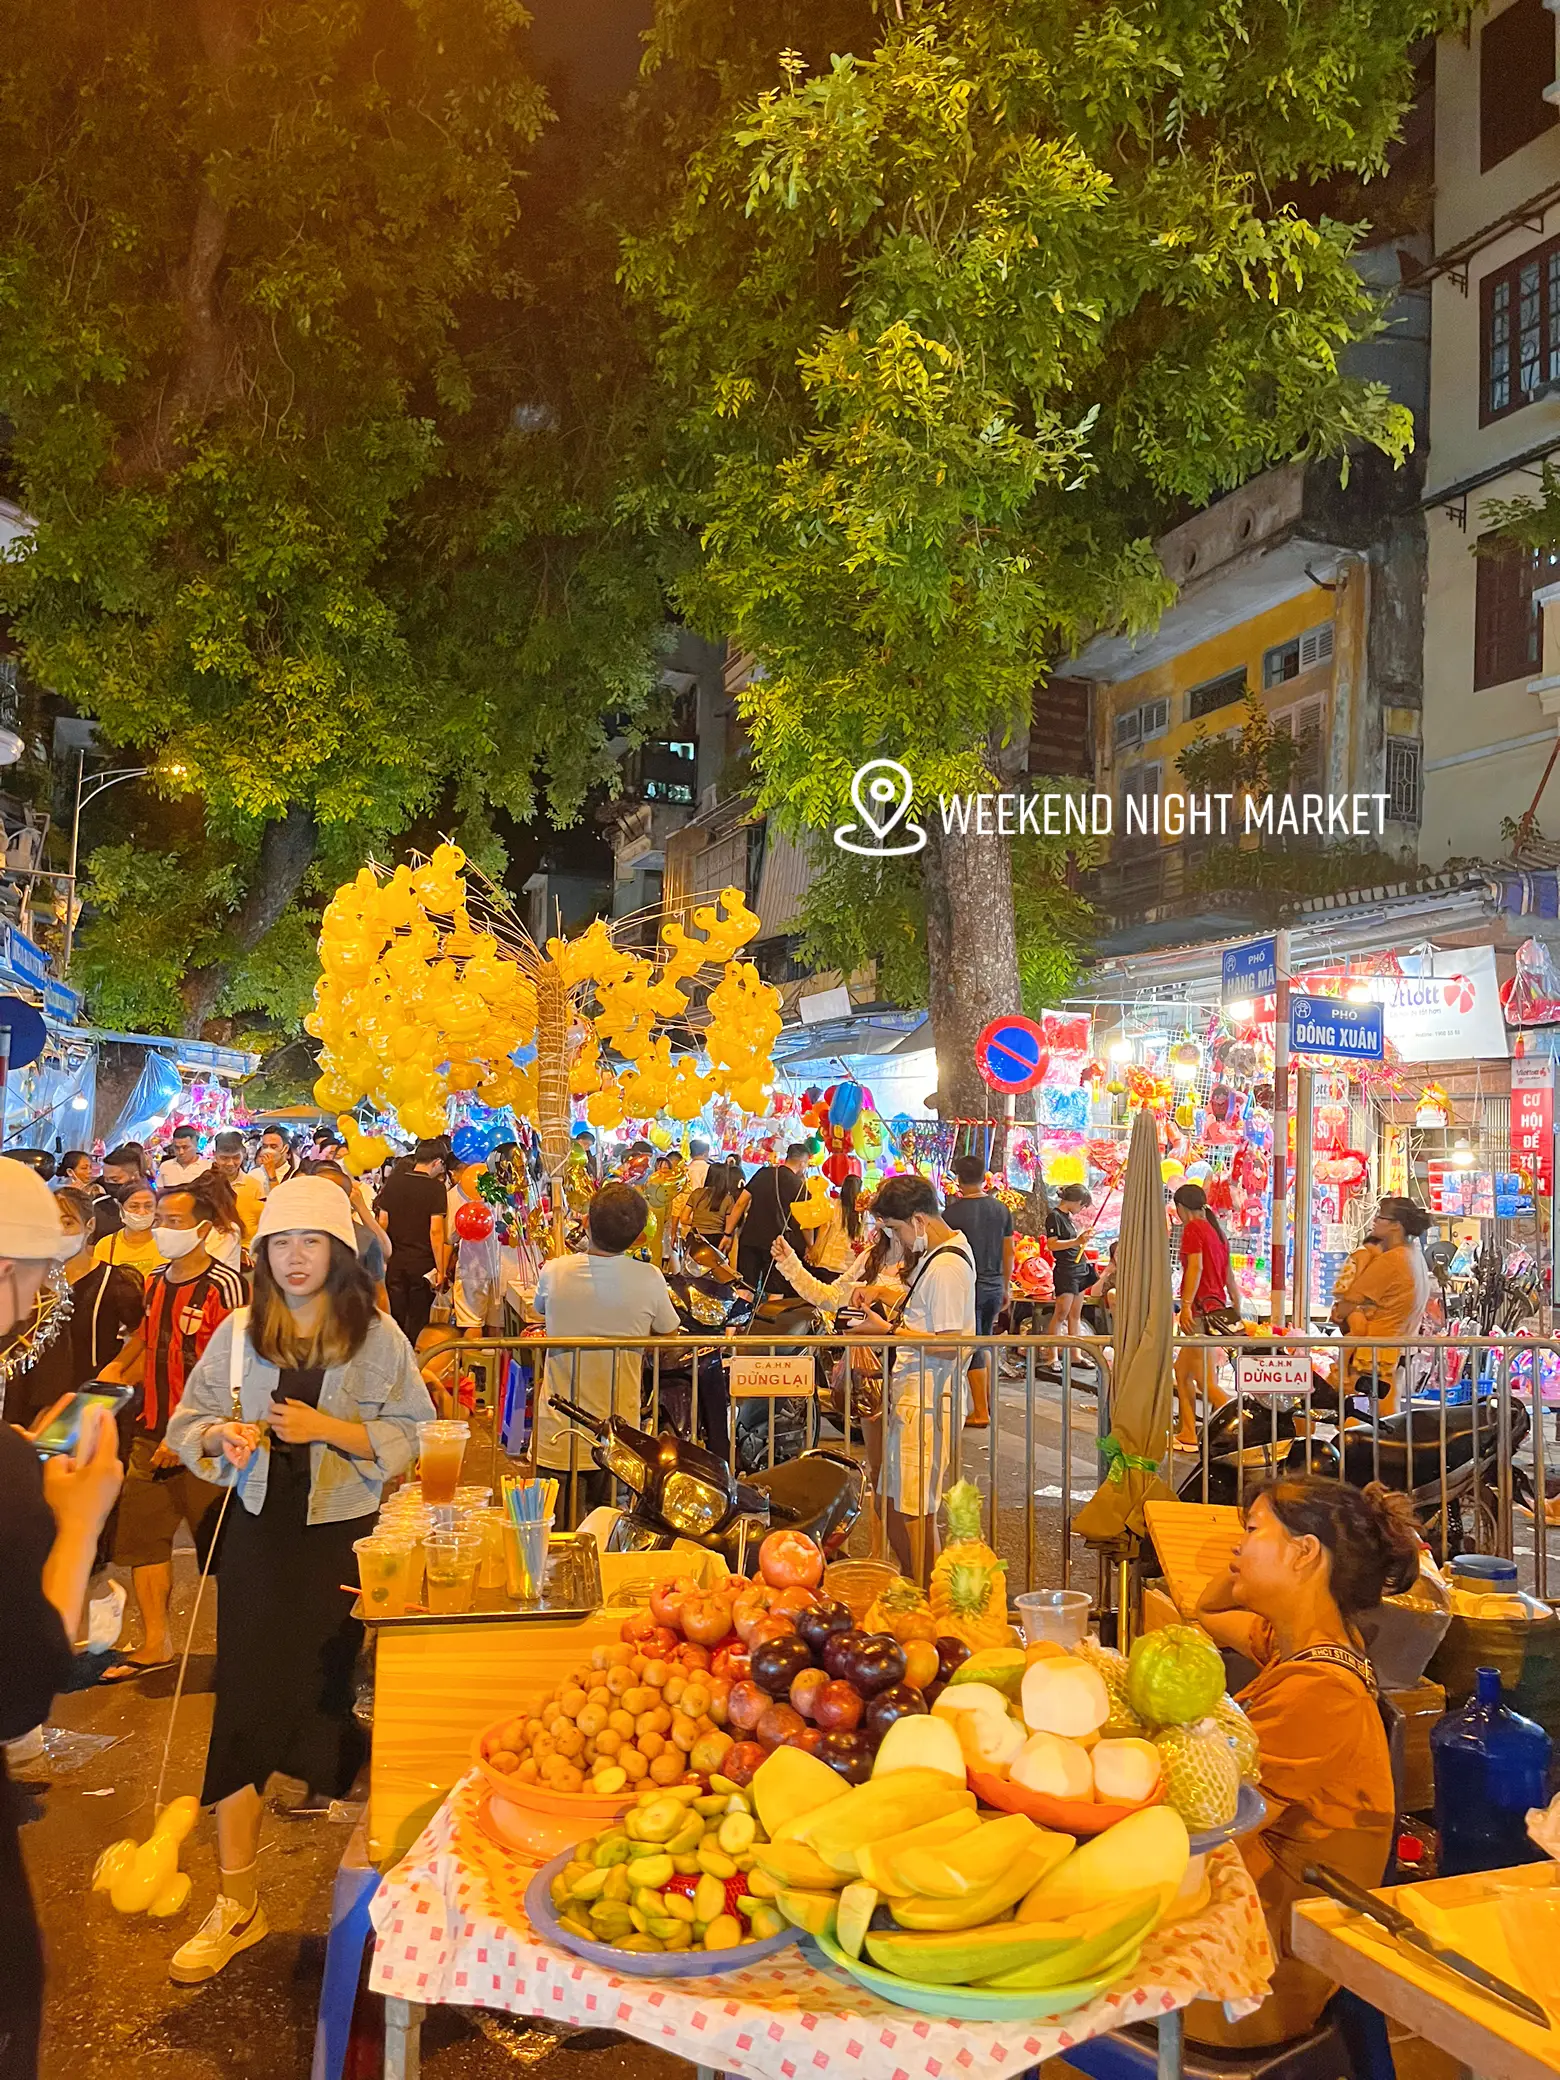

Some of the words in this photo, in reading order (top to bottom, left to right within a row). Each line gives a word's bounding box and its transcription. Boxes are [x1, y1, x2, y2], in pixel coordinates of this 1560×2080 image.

[1248, 948, 1266, 965] PHỐ
[1258, 964, 1275, 989] MÃ
[1296, 1018, 1336, 1046] ĐỒNG
[1339, 1026, 1378, 1050] XUÂN
[1522, 1093, 1541, 1107] CƠ
[1521, 1111, 1543, 1131] HỘI
[737, 1370, 780, 1386] DỪNG
[783, 1374, 808, 1388] LẠI
[1244, 1368, 1282, 1382] DỪNG
[1286, 1372, 1307, 1385] LẠI
